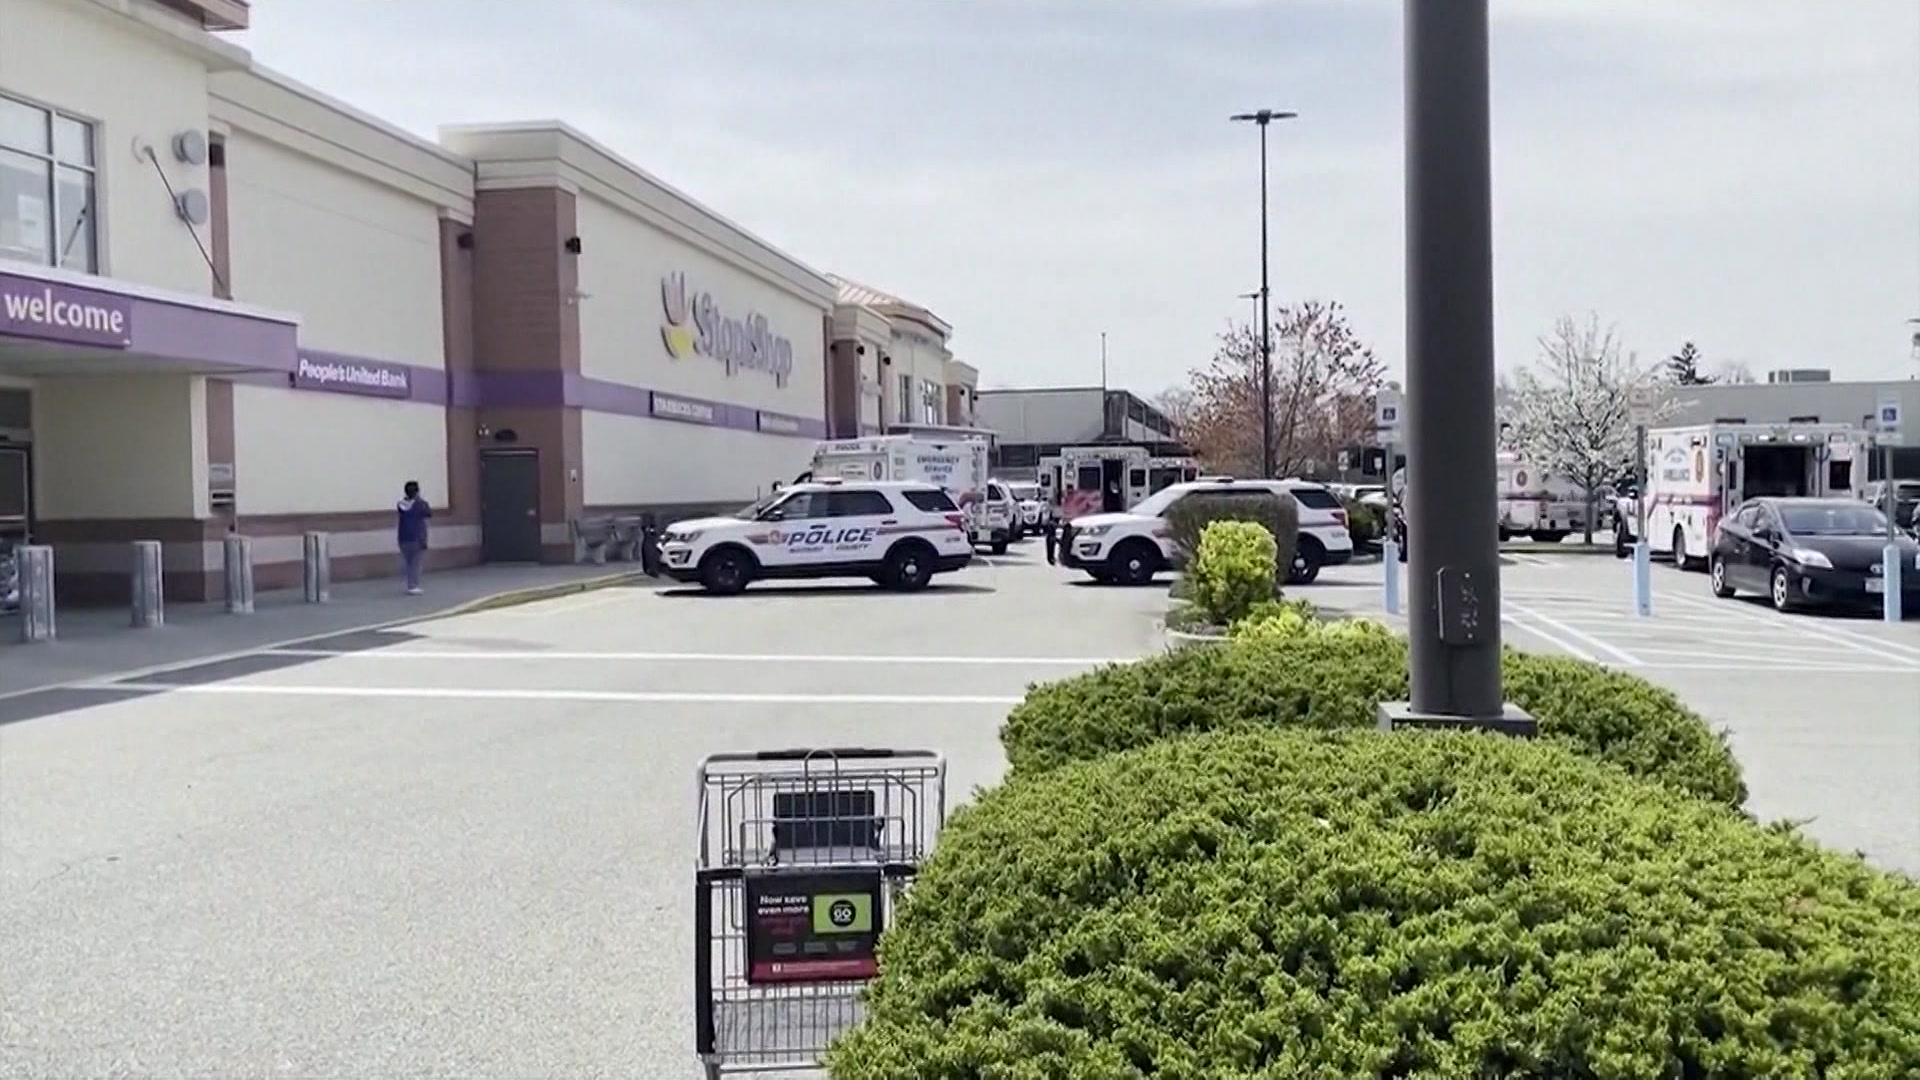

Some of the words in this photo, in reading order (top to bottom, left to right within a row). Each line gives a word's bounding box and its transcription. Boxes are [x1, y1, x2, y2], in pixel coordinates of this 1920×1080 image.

[4, 290, 124, 333] welcome
[299, 358, 344, 383] People's
[346, 365, 381, 385] United
[381, 369, 407, 388] Bank
[917, 456, 960, 464] EMERGENCY
[924, 465, 953, 473] SERVICE
[788, 527, 876, 546] POLICE
[760, 895, 782, 905] Now
[784, 896, 807, 904] save
[758, 906, 781, 915] even
[782, 906, 809, 914] more
